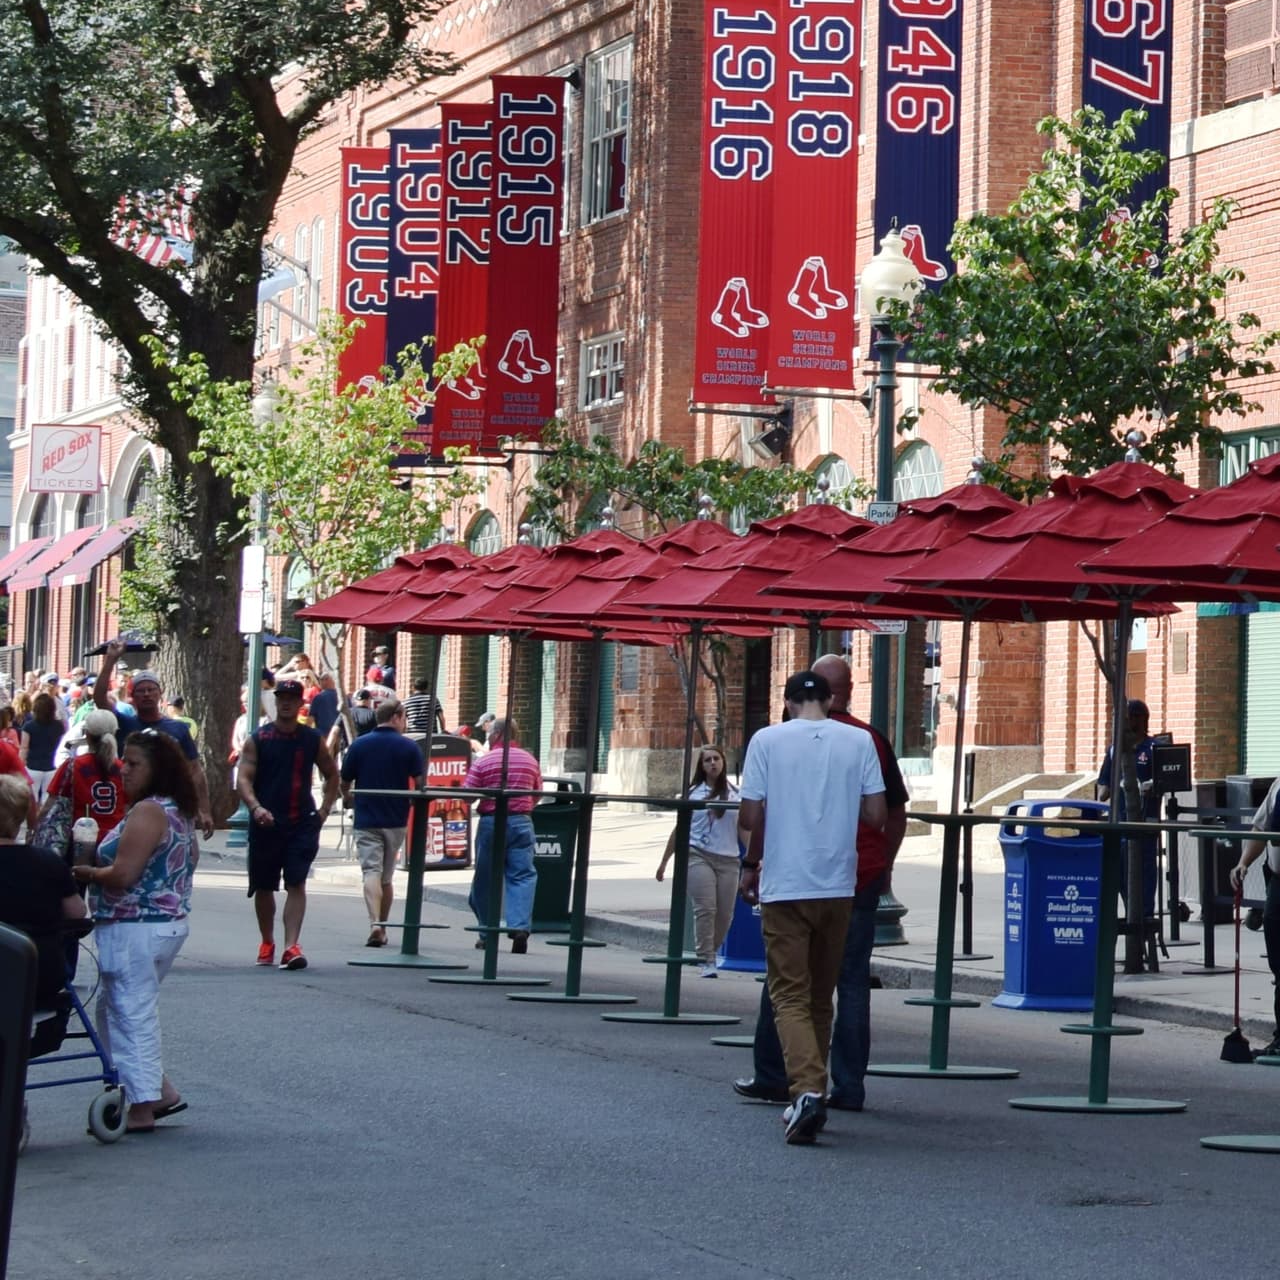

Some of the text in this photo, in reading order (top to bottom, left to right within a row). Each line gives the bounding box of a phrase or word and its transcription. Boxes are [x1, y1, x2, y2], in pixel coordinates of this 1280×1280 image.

[710, 8, 777, 181] 1916
[497, 91, 557, 246] 1915
[445, 119, 493, 264] 1912
[394, 142, 442, 299] 1904
[346, 163, 391, 316] 1903
[792, 330, 826, 343] WORLD
[716, 347, 757, 359] WORLD
[792, 343, 834, 356] SERIES
[777, 356, 847, 371] CHAMPIONS
[702, 373, 765, 386] CHAMPION
[42, 431, 93, 474] RED SOX
[34, 478, 94, 488] TICKETS
[427, 760, 467, 777] ALUTE
[1161, 763, 1182, 772] EXIT
[91, 780, 118, 815] 9
[1048, 902, 1094, 914] Poland Spring
[1053, 927, 1084, 938] WM
